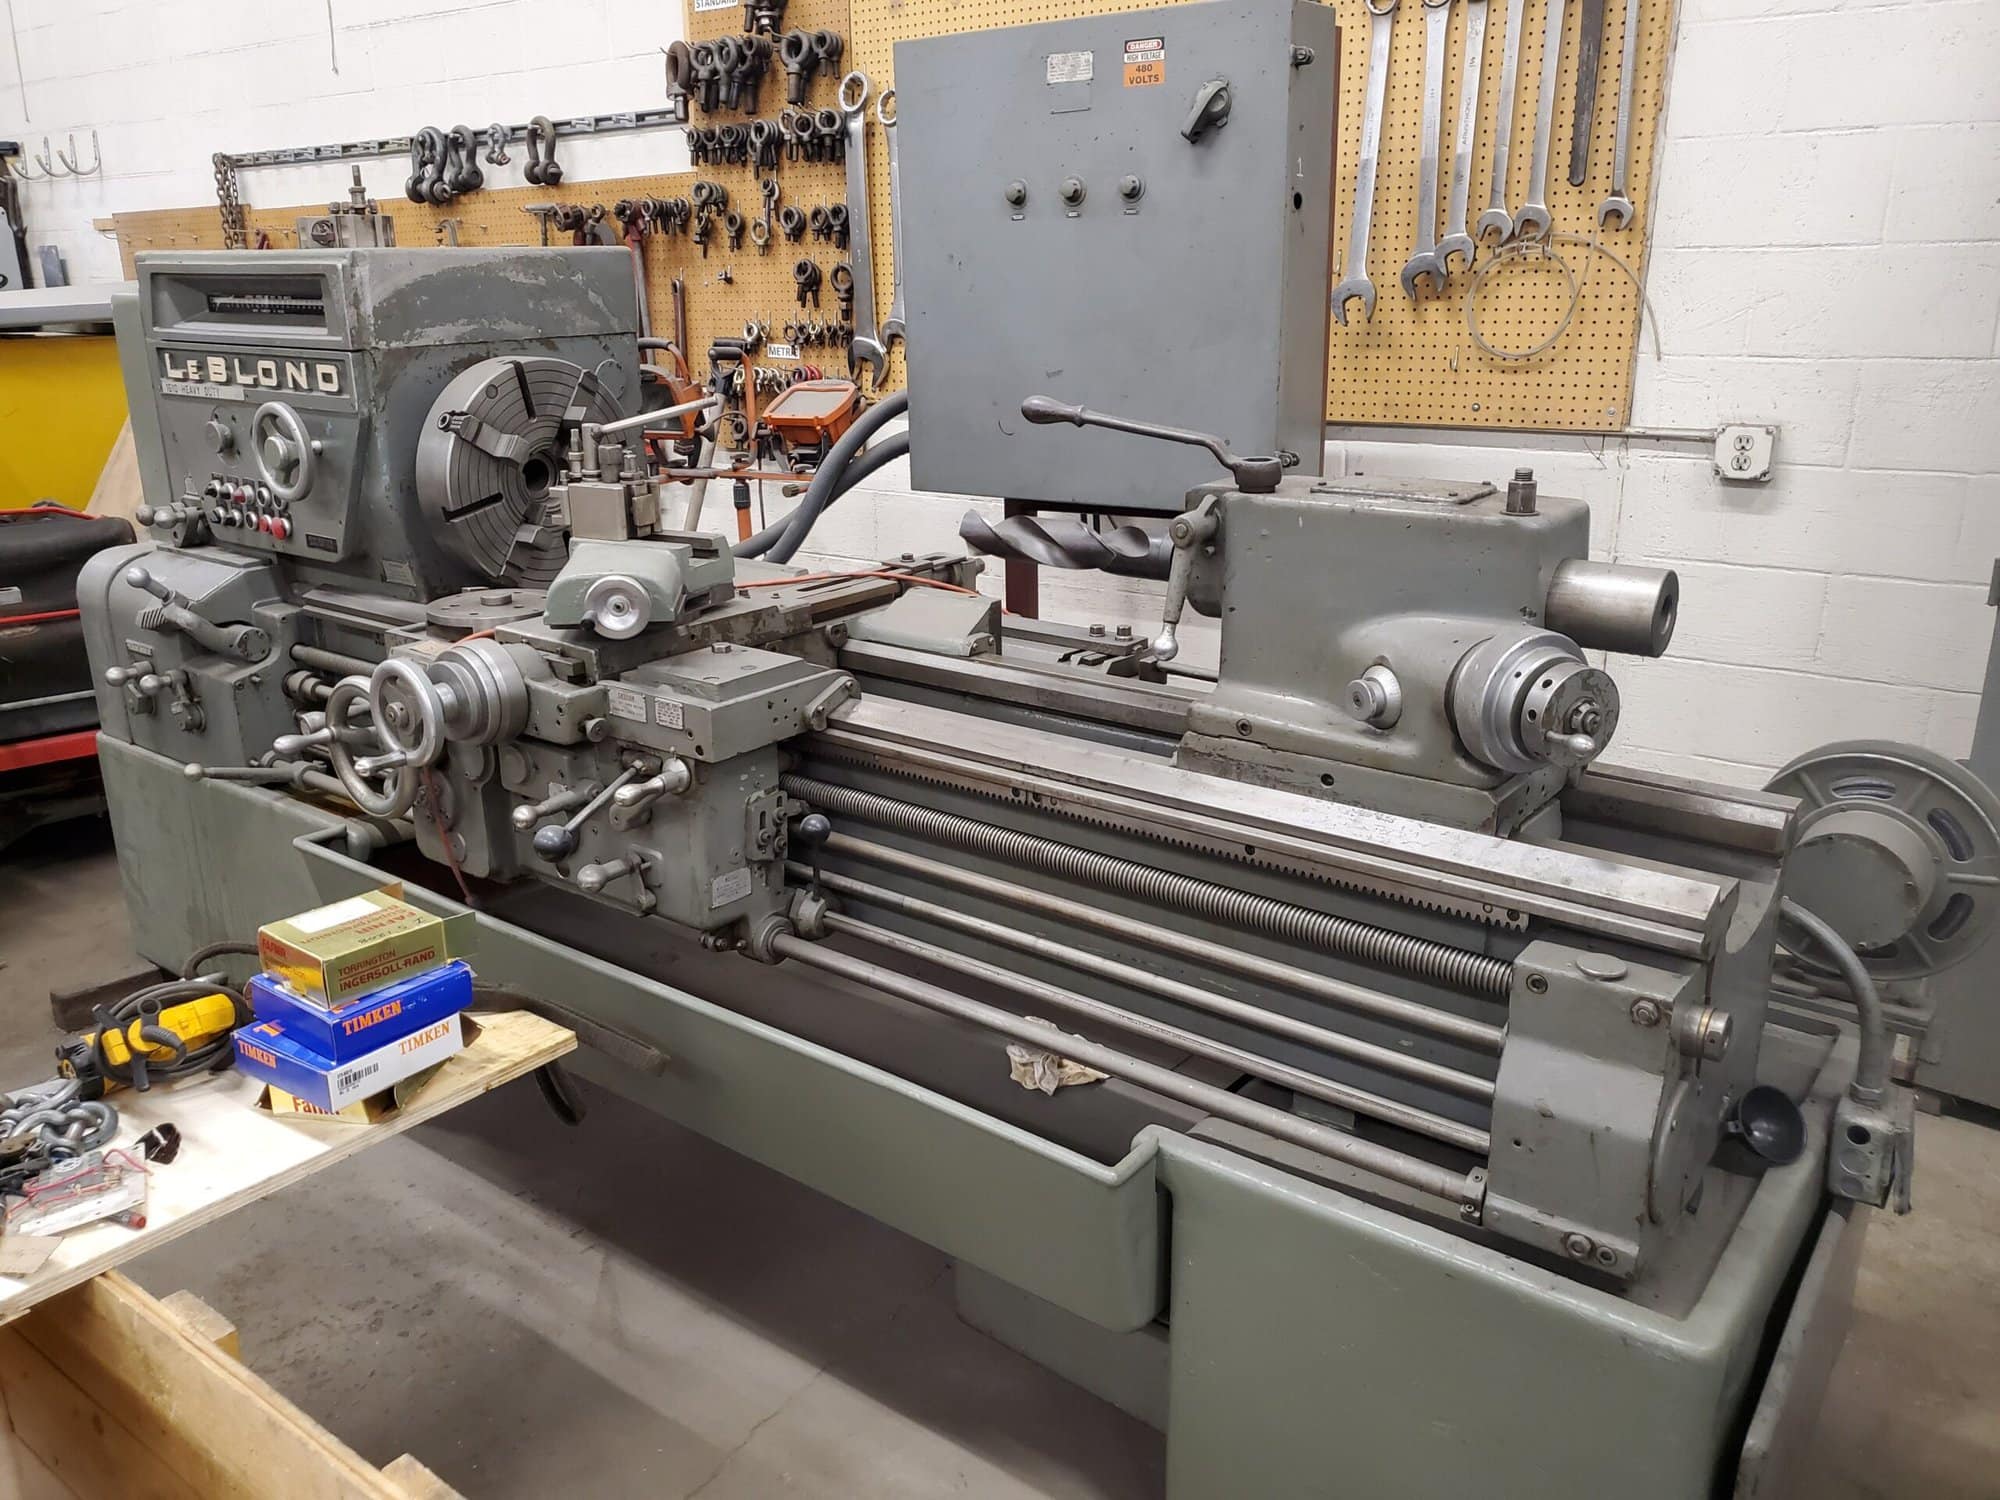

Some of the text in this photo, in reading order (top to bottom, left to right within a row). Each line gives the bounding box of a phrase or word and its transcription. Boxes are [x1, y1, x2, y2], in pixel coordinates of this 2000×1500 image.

[696, 0, 737, 9] STANDA
[1127, 51, 1161, 61] HIGH VOLTAGE
[1136, 64, 1153, 73] 480
[1129, 74, 1160, 85] VOLTS
[769, 346, 798, 357] METRC
[181, 385, 200, 395] HEAVY
[338, 949, 396, 976] TORRINGTON
[339, 950, 435, 992] INGERSOLL-RAND
[342, 1000, 402, 1035] TIMKEN
[399, 1021, 450, 1055] TIMKEN
[237, 1039, 276, 1068] TIMKEN
